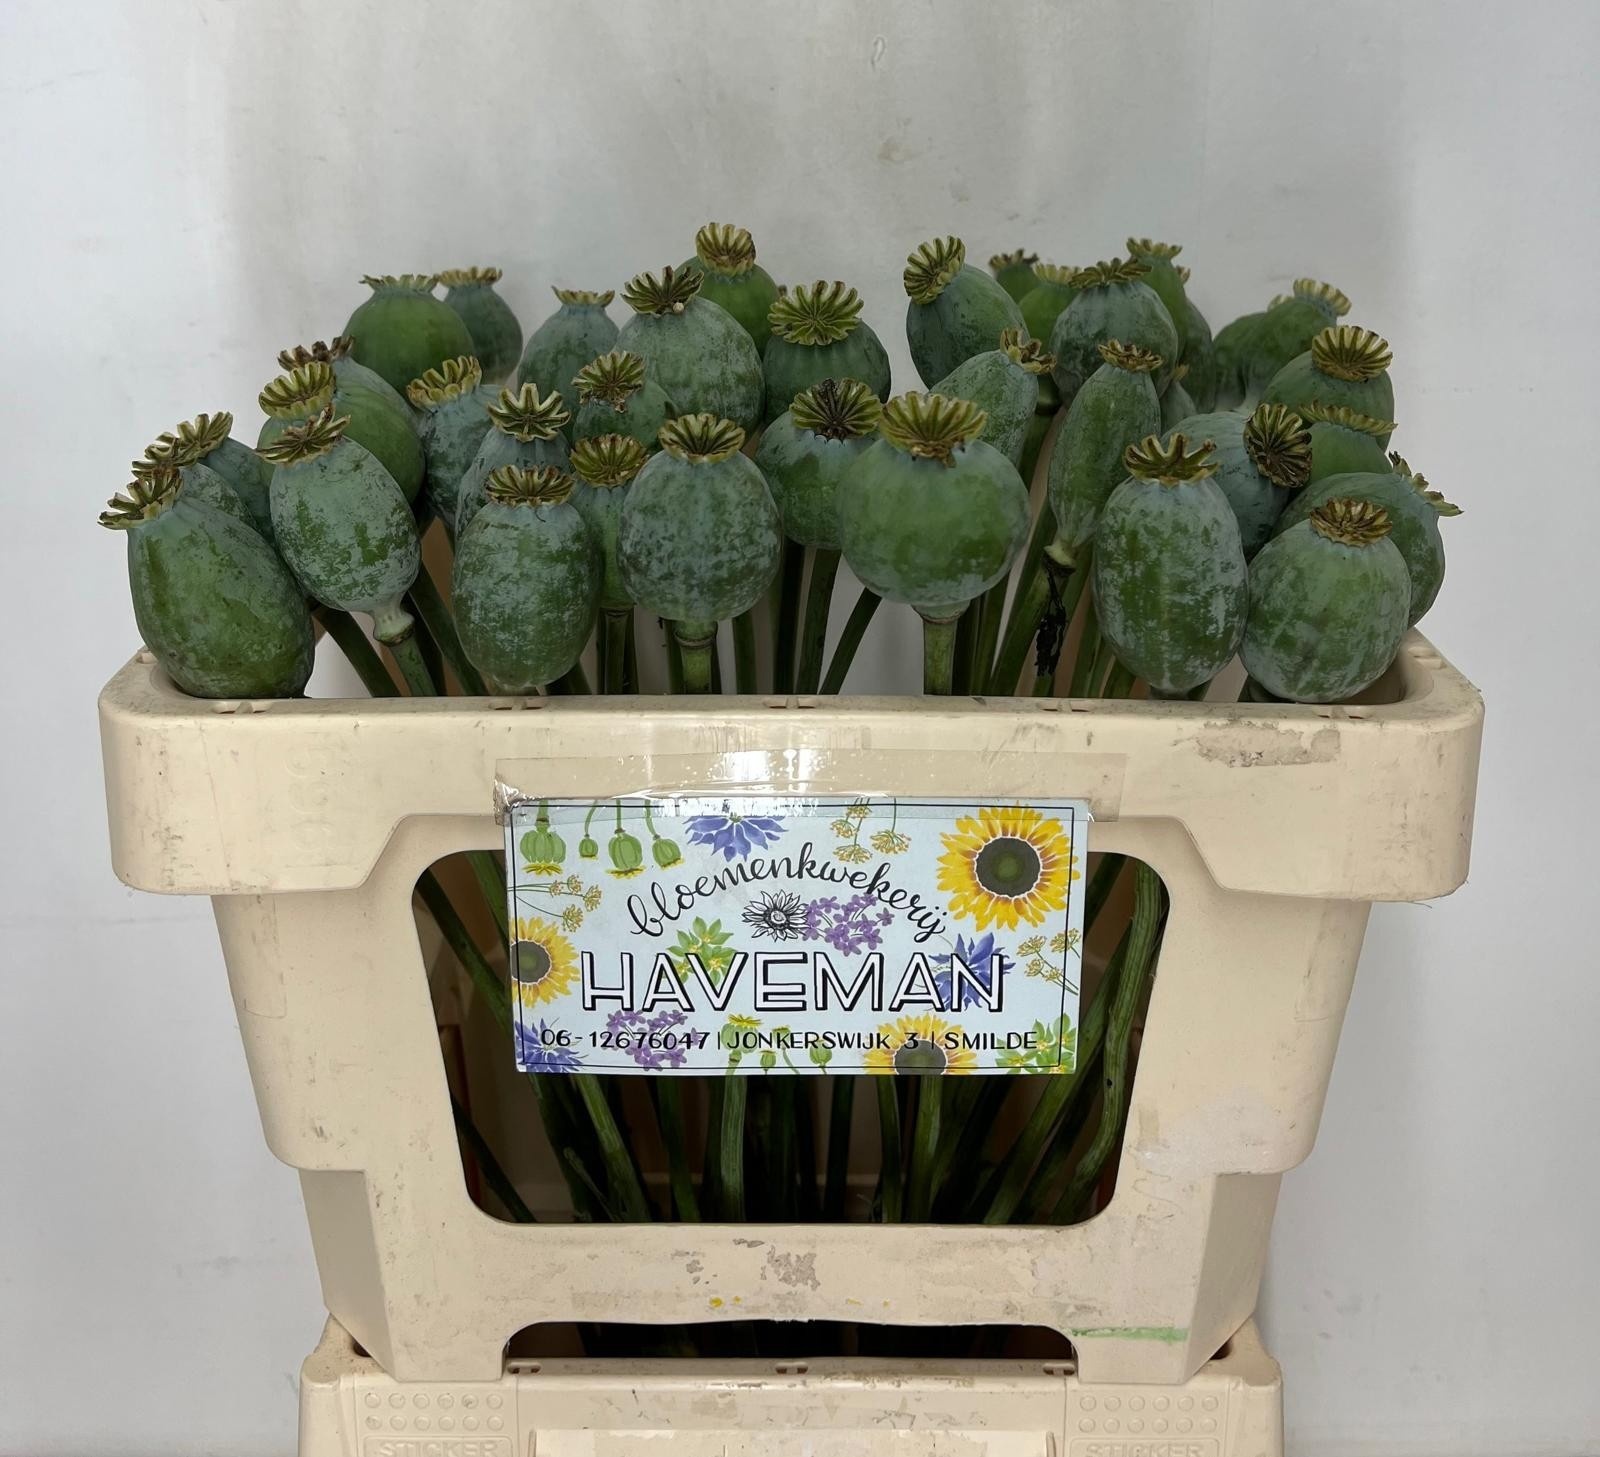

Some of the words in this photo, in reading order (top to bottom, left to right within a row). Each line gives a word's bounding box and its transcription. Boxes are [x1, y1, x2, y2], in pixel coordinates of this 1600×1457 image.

[626, 842, 949, 943] bloemenkwekerij
[581, 951, 1006, 1012] HAVEMAN
[541, 1029, 710, 1050] 06-12676047
[727, 1031, 891, 1050] JONKERSWIJK
[903, 1031, 919, 1049] 3
[944, 1031, 1037, 1050] SMILDE
[379, 1440, 500, 1457] STICKER
